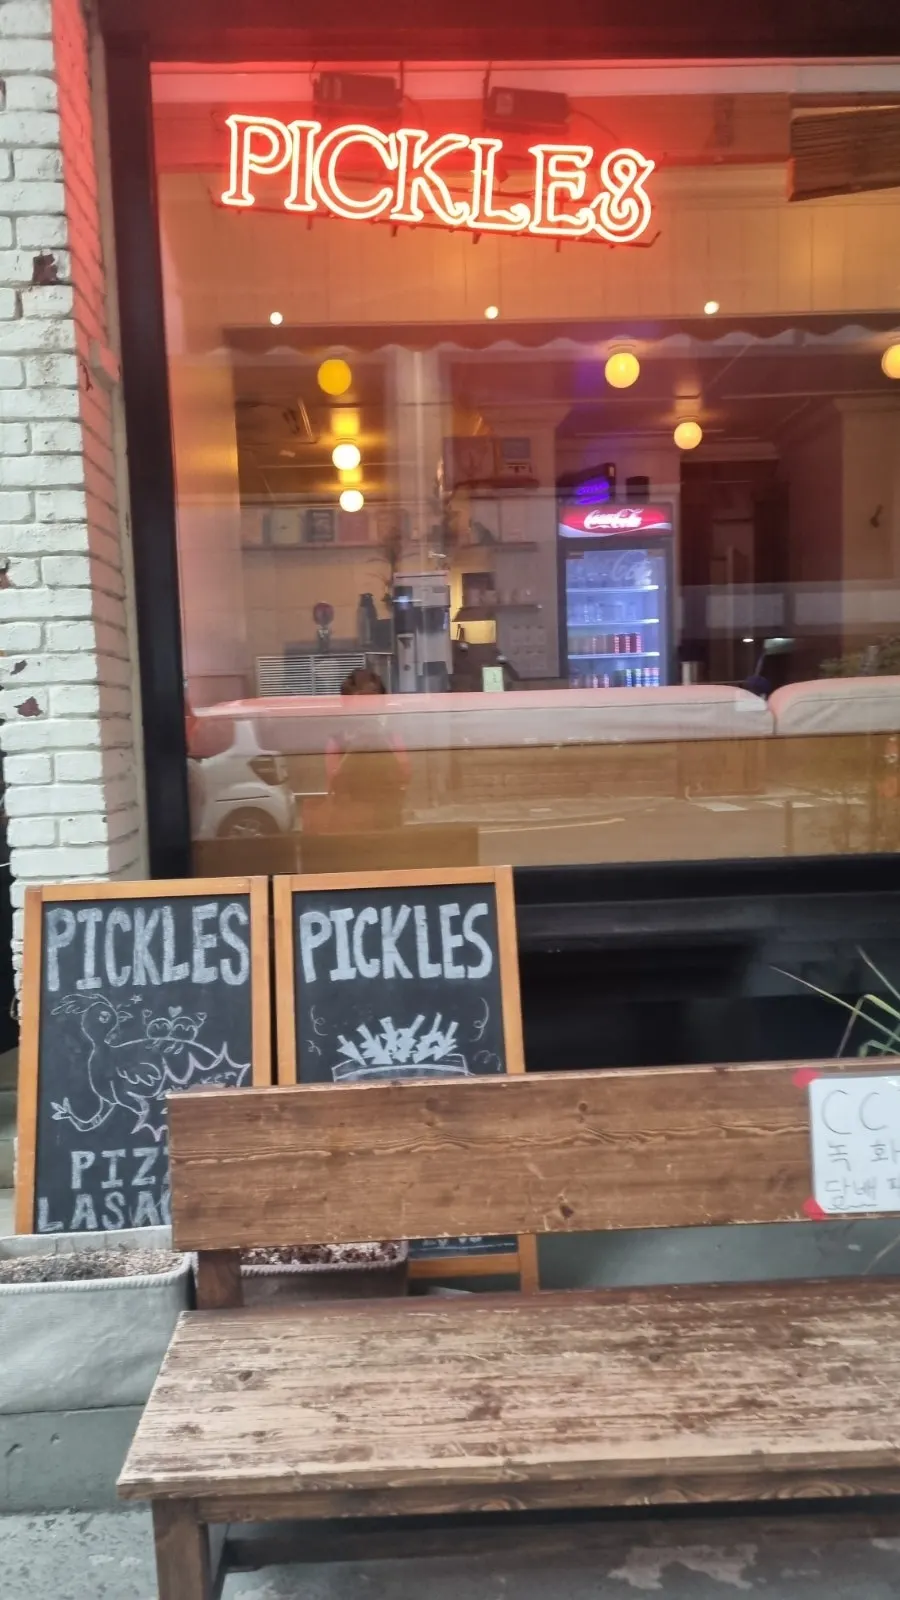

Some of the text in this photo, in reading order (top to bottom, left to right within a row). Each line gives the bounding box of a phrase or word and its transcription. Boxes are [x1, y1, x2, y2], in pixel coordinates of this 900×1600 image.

[221, 114, 655, 242] PICKLES
[45, 902, 249, 991] PICKLES
[300, 902, 493, 982] PICKLES
[821, 1089, 900, 1135] CC
[70, 1146, 171, 1189] PIZ
